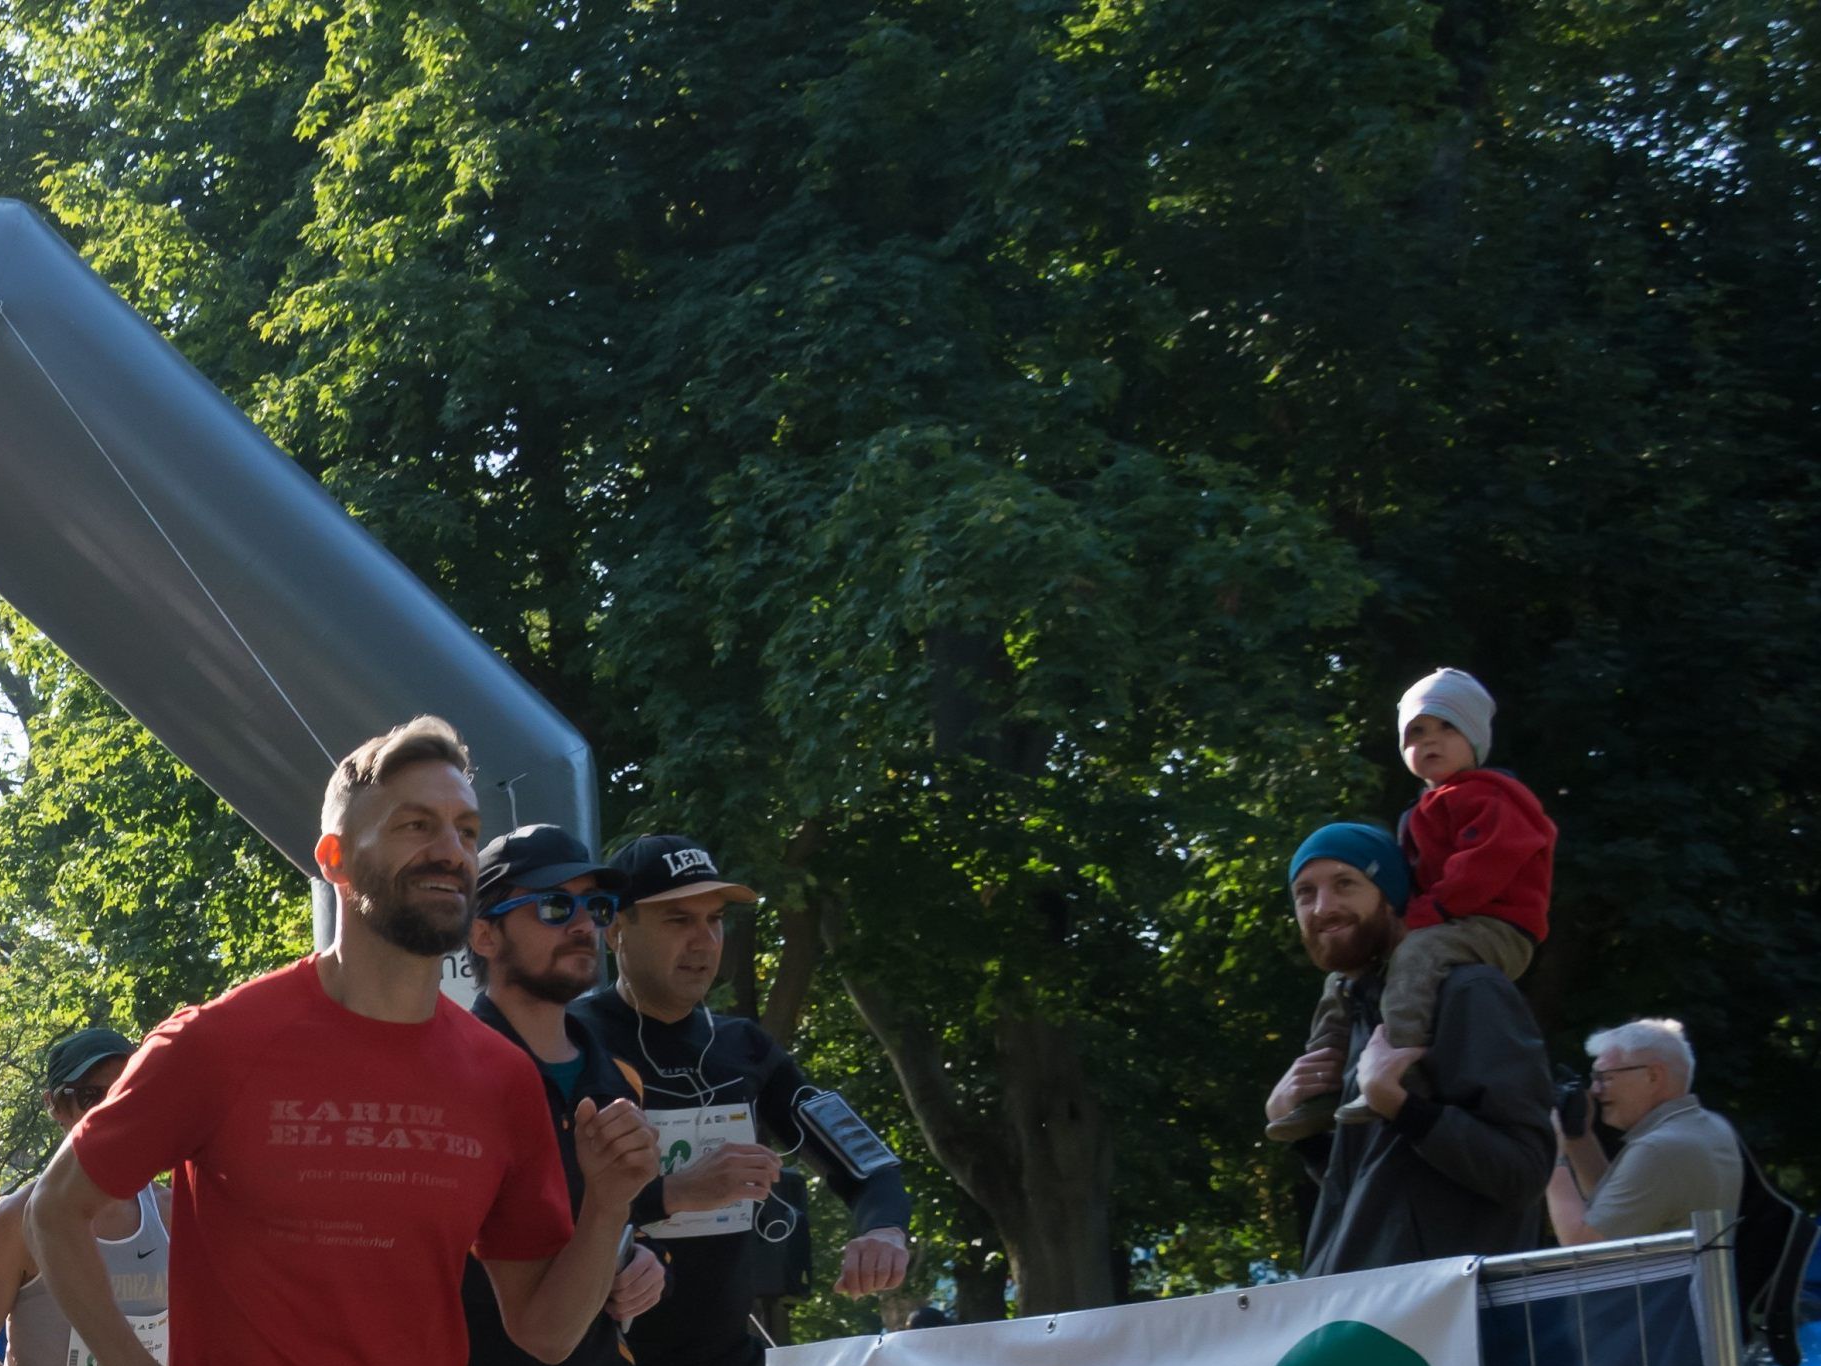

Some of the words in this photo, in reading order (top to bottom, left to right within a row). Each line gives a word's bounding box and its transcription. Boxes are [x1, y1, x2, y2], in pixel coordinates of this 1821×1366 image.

[269, 1099, 446, 1128] KARIM
[268, 1124, 332, 1146] EL
[345, 1126, 483, 1159] SAYED
